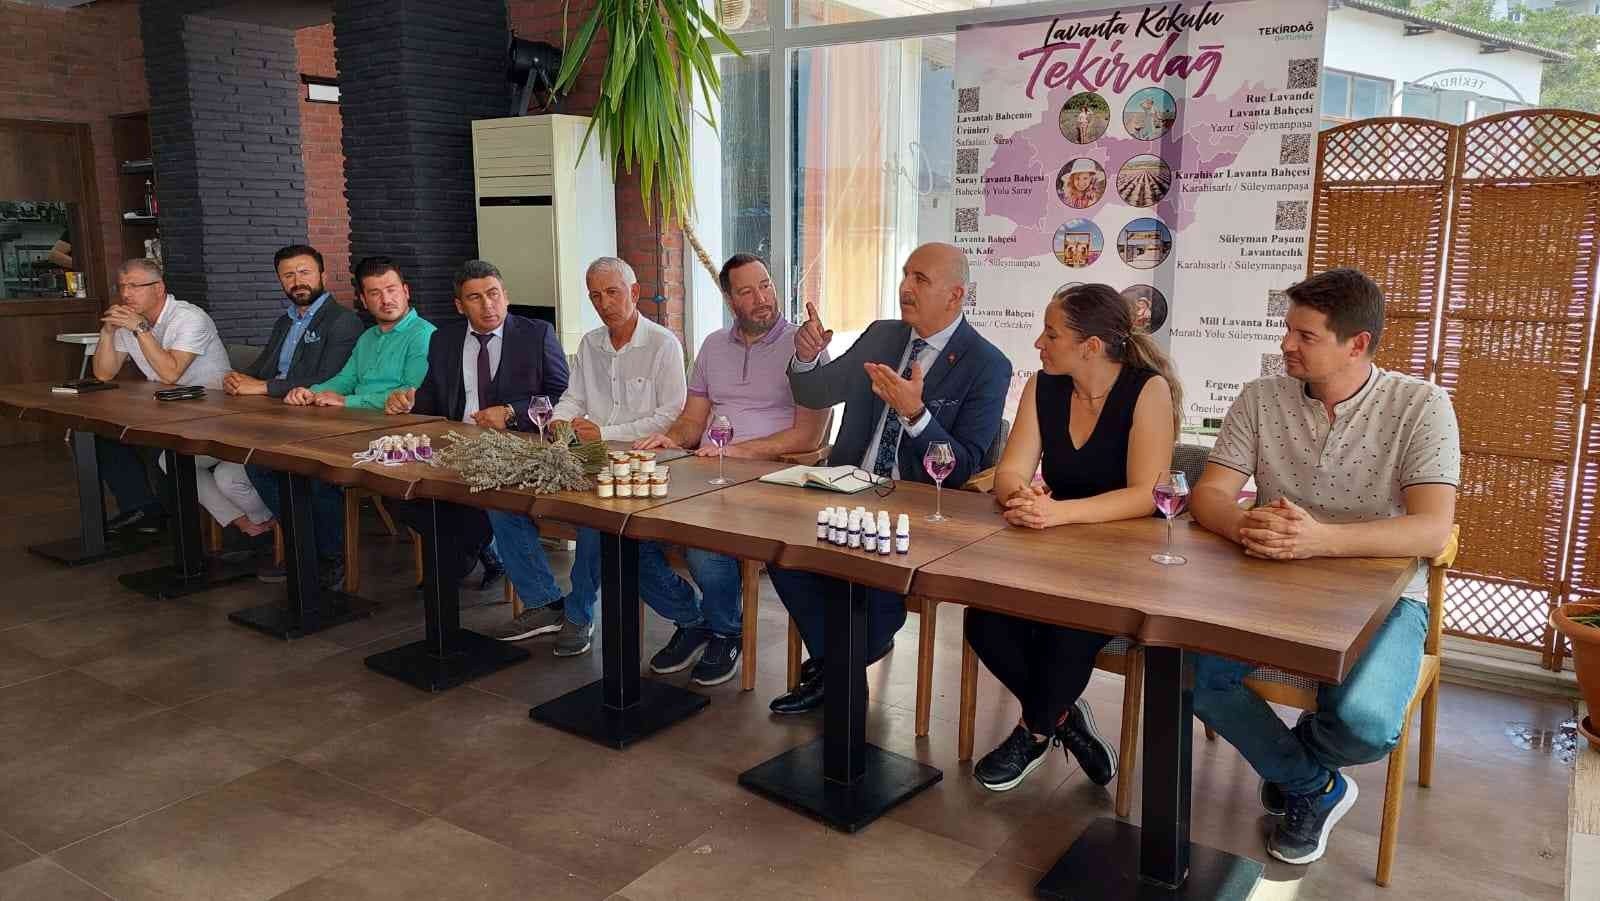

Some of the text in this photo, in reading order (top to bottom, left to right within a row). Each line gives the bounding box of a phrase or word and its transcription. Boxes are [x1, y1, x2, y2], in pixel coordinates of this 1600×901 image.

[1044, 1, 1224, 47] Lavanta Kokulu
[1258, 21, 1314, 35] TEKİRDAĞ
[1018, 32, 1225, 99] Tekirdağ
[1270, 91, 1314, 102] Lavande
[1229, 105, 1313, 118] Lavanta Bahçesi
[1243, 119, 1313, 132] Süleymanpaşa
[980, 175, 1012, 184] Lavanta
[1175, 167, 1311, 180] Karahisar Lavanta Bahçesi
[1240, 181, 1309, 193] Süleymanpaşa
[954, 234, 986, 243] Lavanta
[1219, 234, 1267, 245] Süleyman
[1222, 317, 1263, 327] Lavanta
[1204, 379, 1241, 391] Ergene
